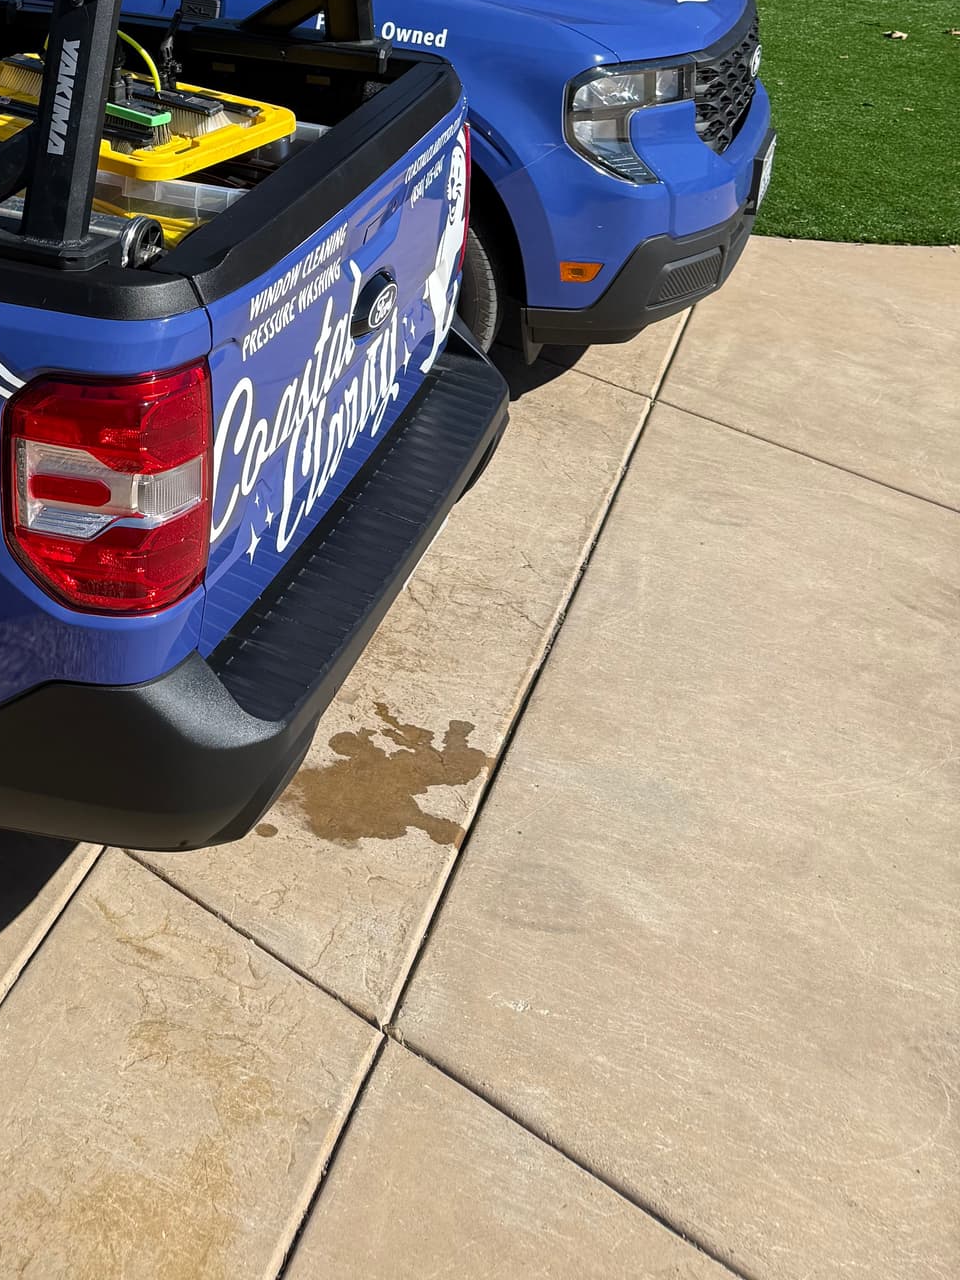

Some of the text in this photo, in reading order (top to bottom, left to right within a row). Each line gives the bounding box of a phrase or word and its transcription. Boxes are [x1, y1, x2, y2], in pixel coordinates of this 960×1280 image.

[381, 21, 448, 48] Owned
[46, 38, 81, 156] YAKIMA
[242, 256, 341, 362] PRESSURE WASHING
[249, 222, 348, 321] WINDOW CLEANING
[373, 287, 396, 325] Ford
[210, 260, 361, 543] Coastal
[276, 306, 400, 553] Clarity
